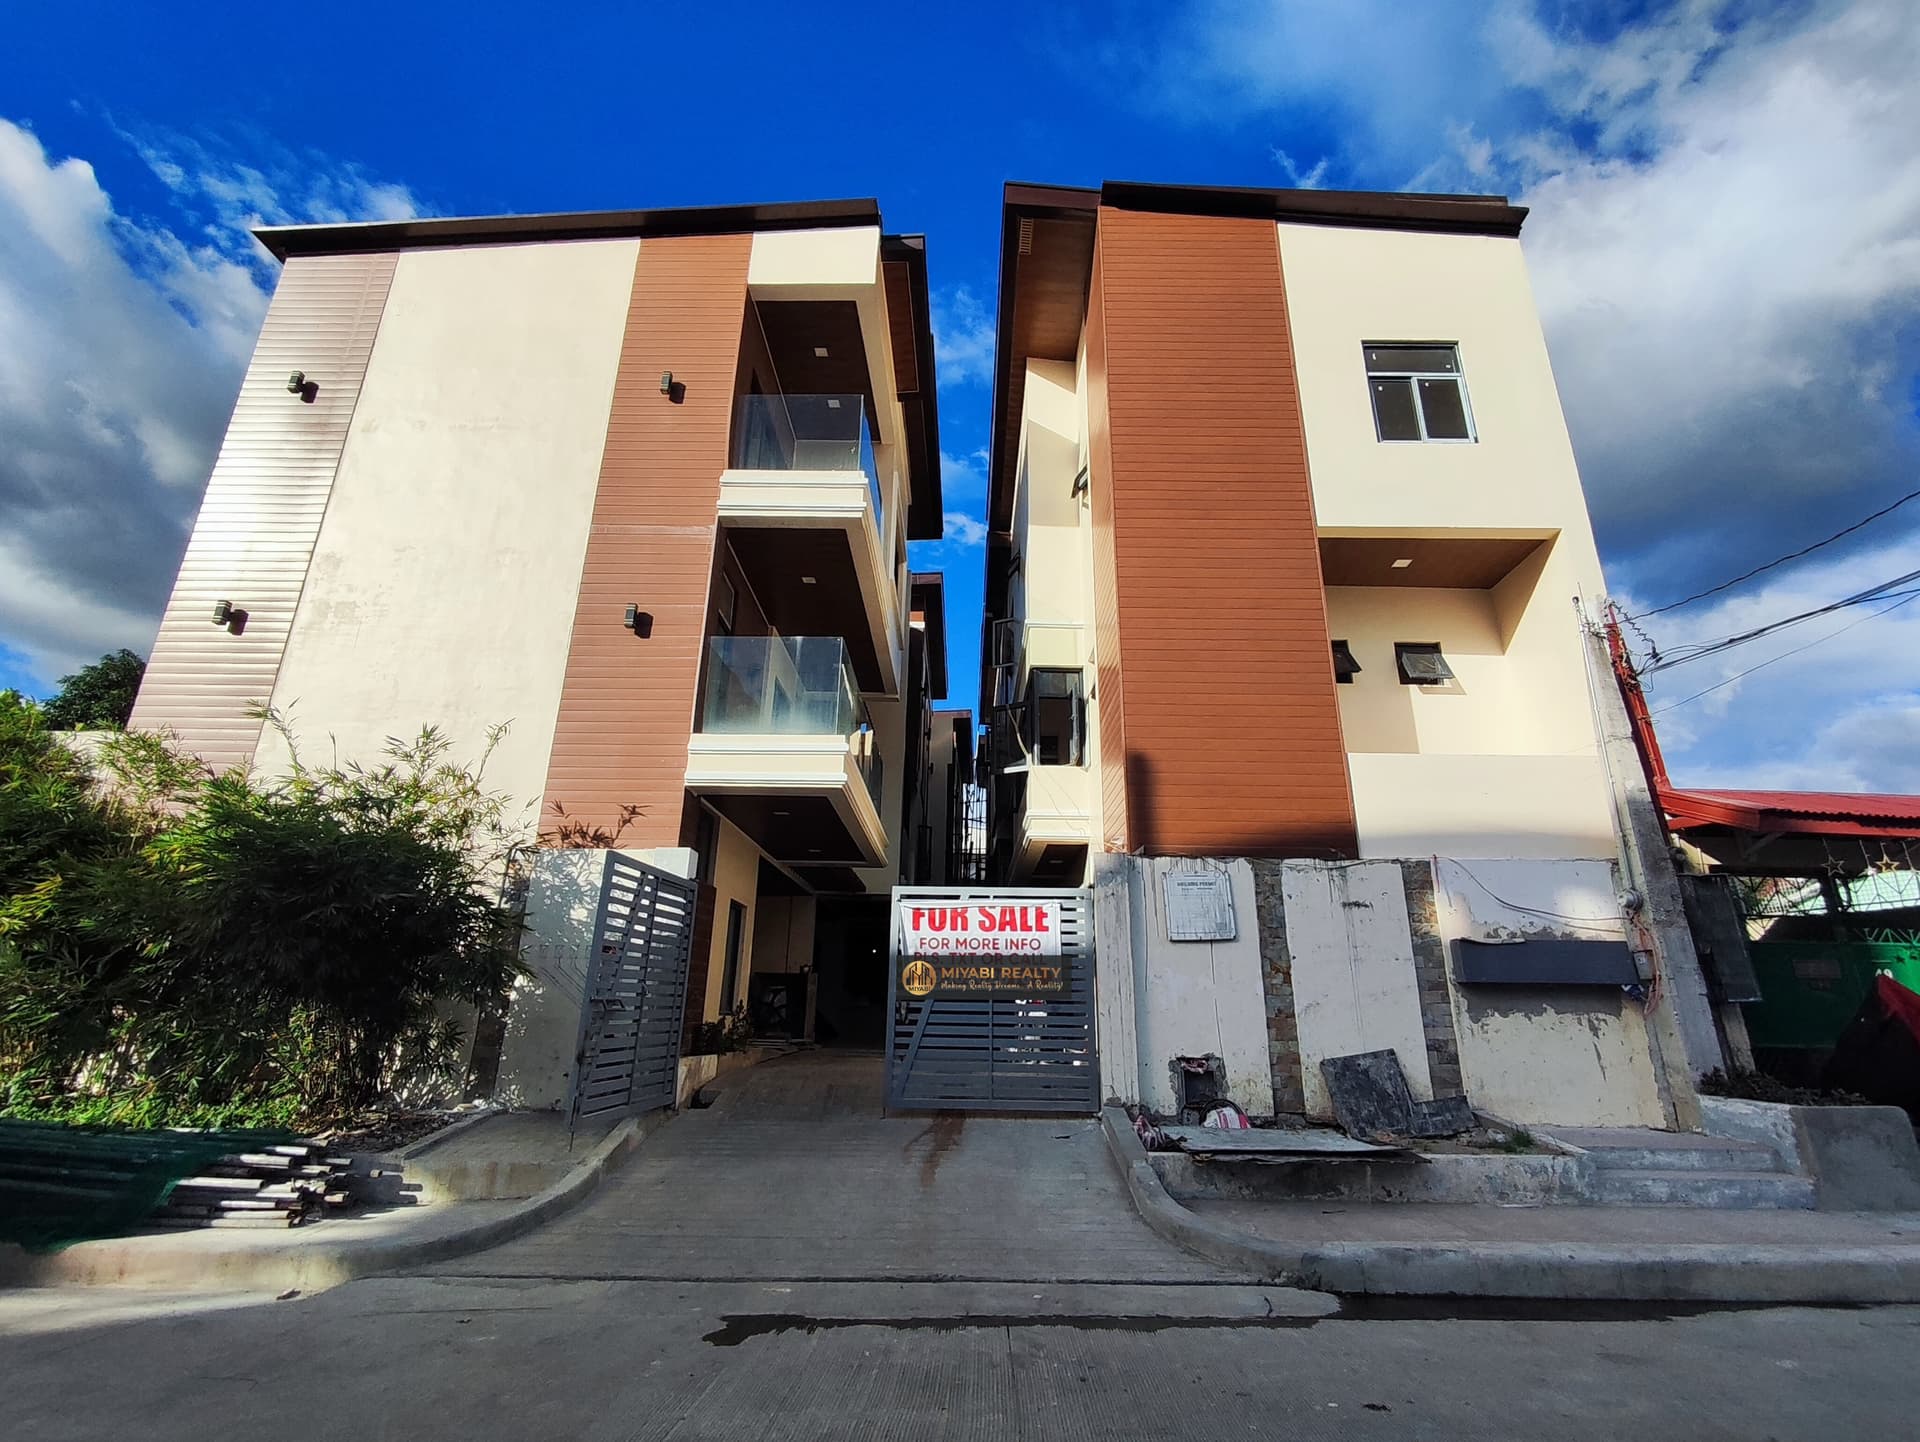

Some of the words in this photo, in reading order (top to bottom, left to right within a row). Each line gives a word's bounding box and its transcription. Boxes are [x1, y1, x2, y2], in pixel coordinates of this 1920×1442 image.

[912, 907, 968, 931] FOR
[978, 906, 1049, 931] SALE
[919, 937, 949, 950] FOR
[956, 937, 1000, 950] MORE
[1005, 938, 1041, 951] INFO
[949, 952, 978, 965] TXT
[981, 951, 1004, 965] OR
[1008, 951, 1048, 965] CALL
